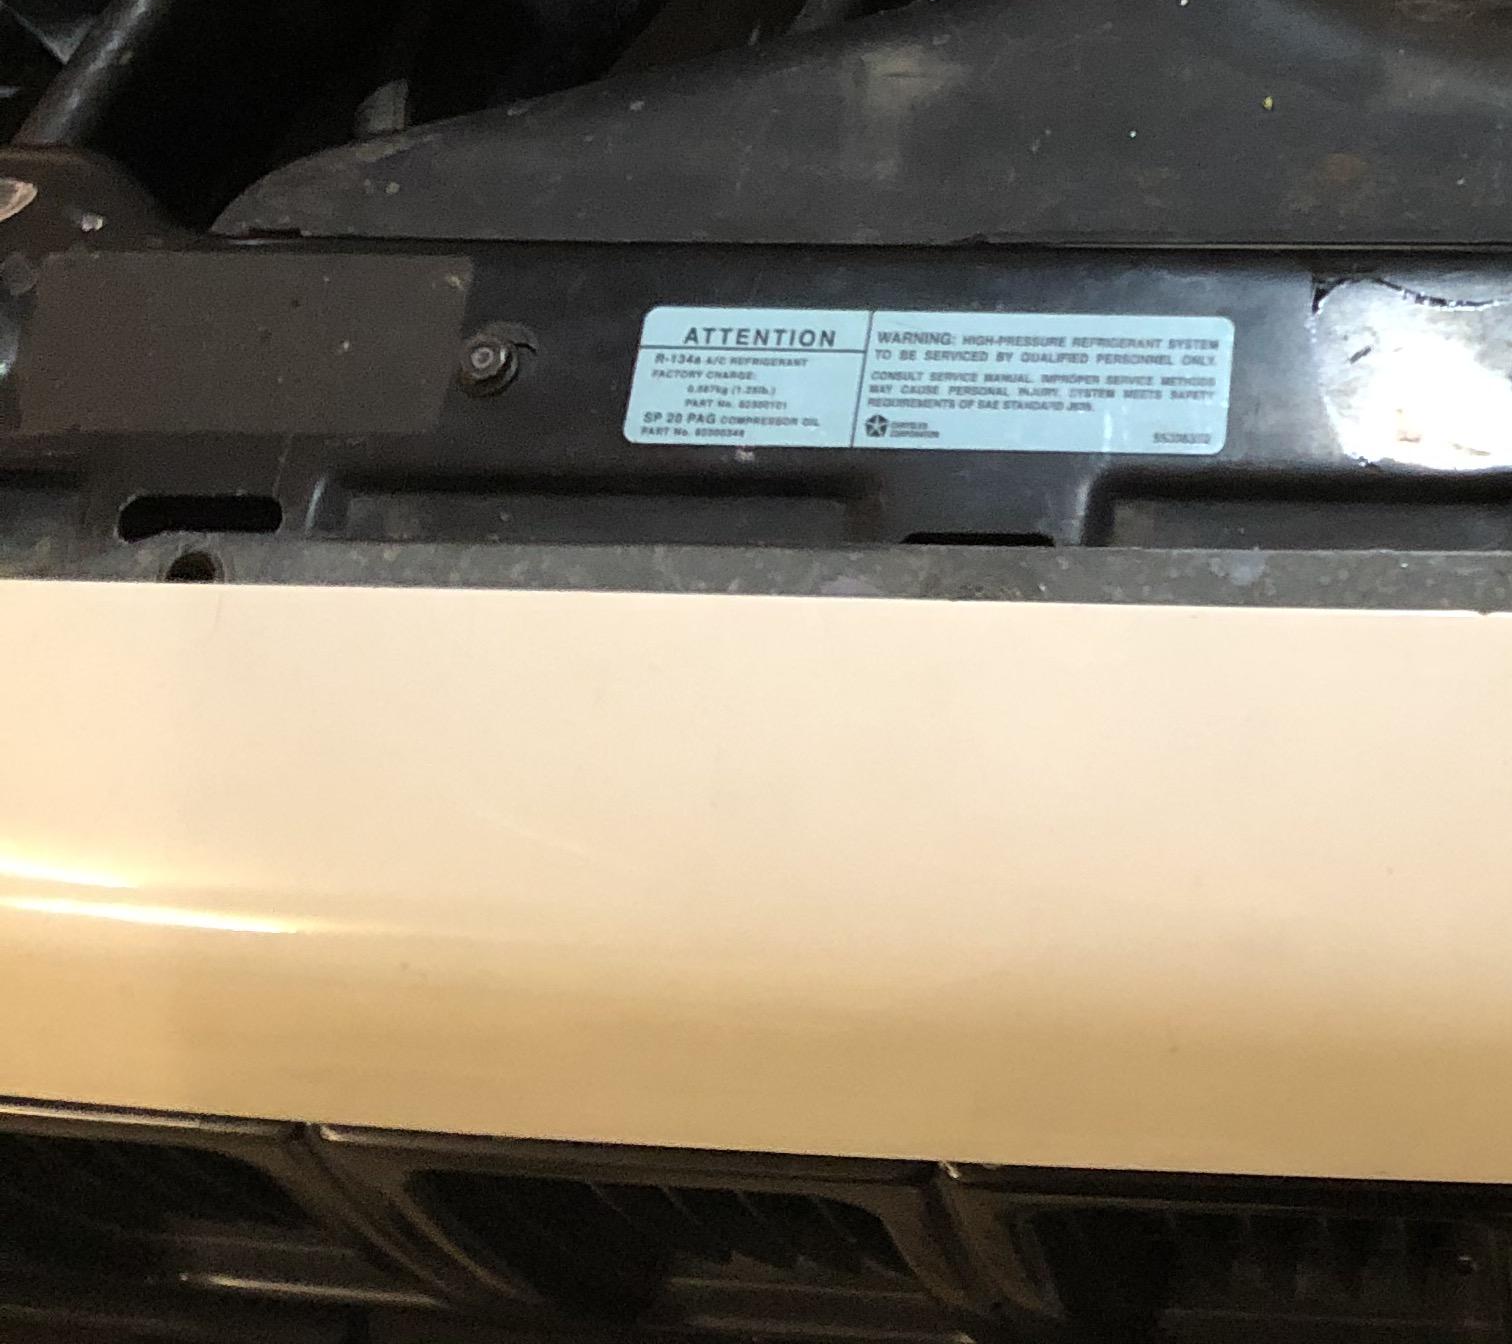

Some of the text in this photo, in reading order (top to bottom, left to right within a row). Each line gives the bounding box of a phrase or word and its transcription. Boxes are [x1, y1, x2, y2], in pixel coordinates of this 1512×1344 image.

[684, 327, 836, 347] ATTENTION
[877, 331, 1219, 350] WARNING: HIGH-PRESSURE REFRIGERANT SYSTEM
[655, 353, 808, 367] R-134a A/C REFRIGERANT
[875, 349, 892, 361] TO
[899, 349, 917, 361] BE
[925, 350, 989, 362] SERVICED
[995, 351, 1014, 362] BY
[1020, 352, 1088, 364] QUALIFIED
[1096, 353, 1172, 366] PERSONNEL
[652, 370, 702, 379] FACTORY
[871, 371, 923, 381] CONSULT
[929, 372, 978, 382] SERVICE
[1106, 375, 1153, 385] SERVICE
[869, 384, 893, 394] MAY
[900, 385, 939, 395] CAUSE
[948, 386, 1009, 396] PERSONAL
[685, 399, 714, 408] PART
[868, 398, 955, 408] REQUIREMENTS
[643, 411, 821, 427] SP 20 PAG COMPRESSOR OIL
[641, 427, 670, 436] PART
